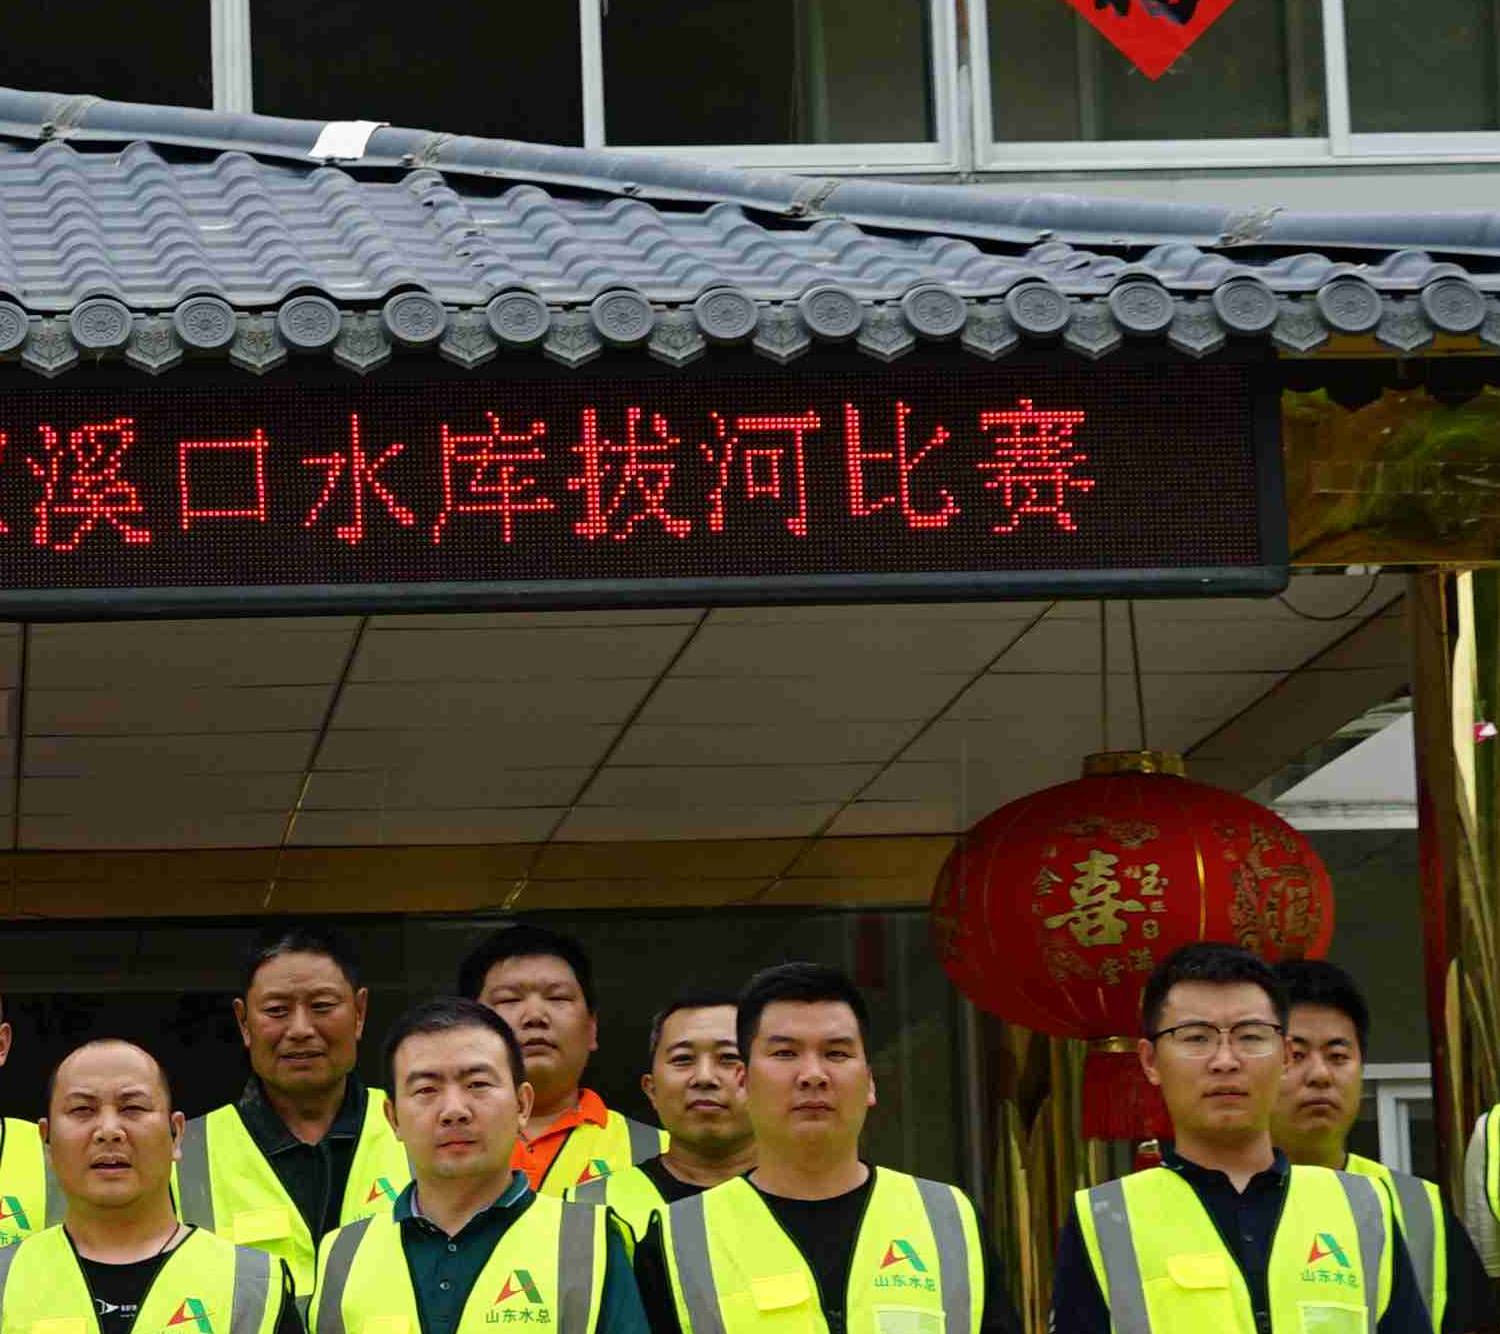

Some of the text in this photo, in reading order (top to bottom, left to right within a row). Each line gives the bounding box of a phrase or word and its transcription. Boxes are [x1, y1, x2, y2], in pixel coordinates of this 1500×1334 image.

[1045, 848, 1147, 947] 喜
[874, 1274, 937, 1292] 山东水总
[1300, 1269, 1360, 1288] 山东水总
[485, 1308, 551, 1324] 山东水总
